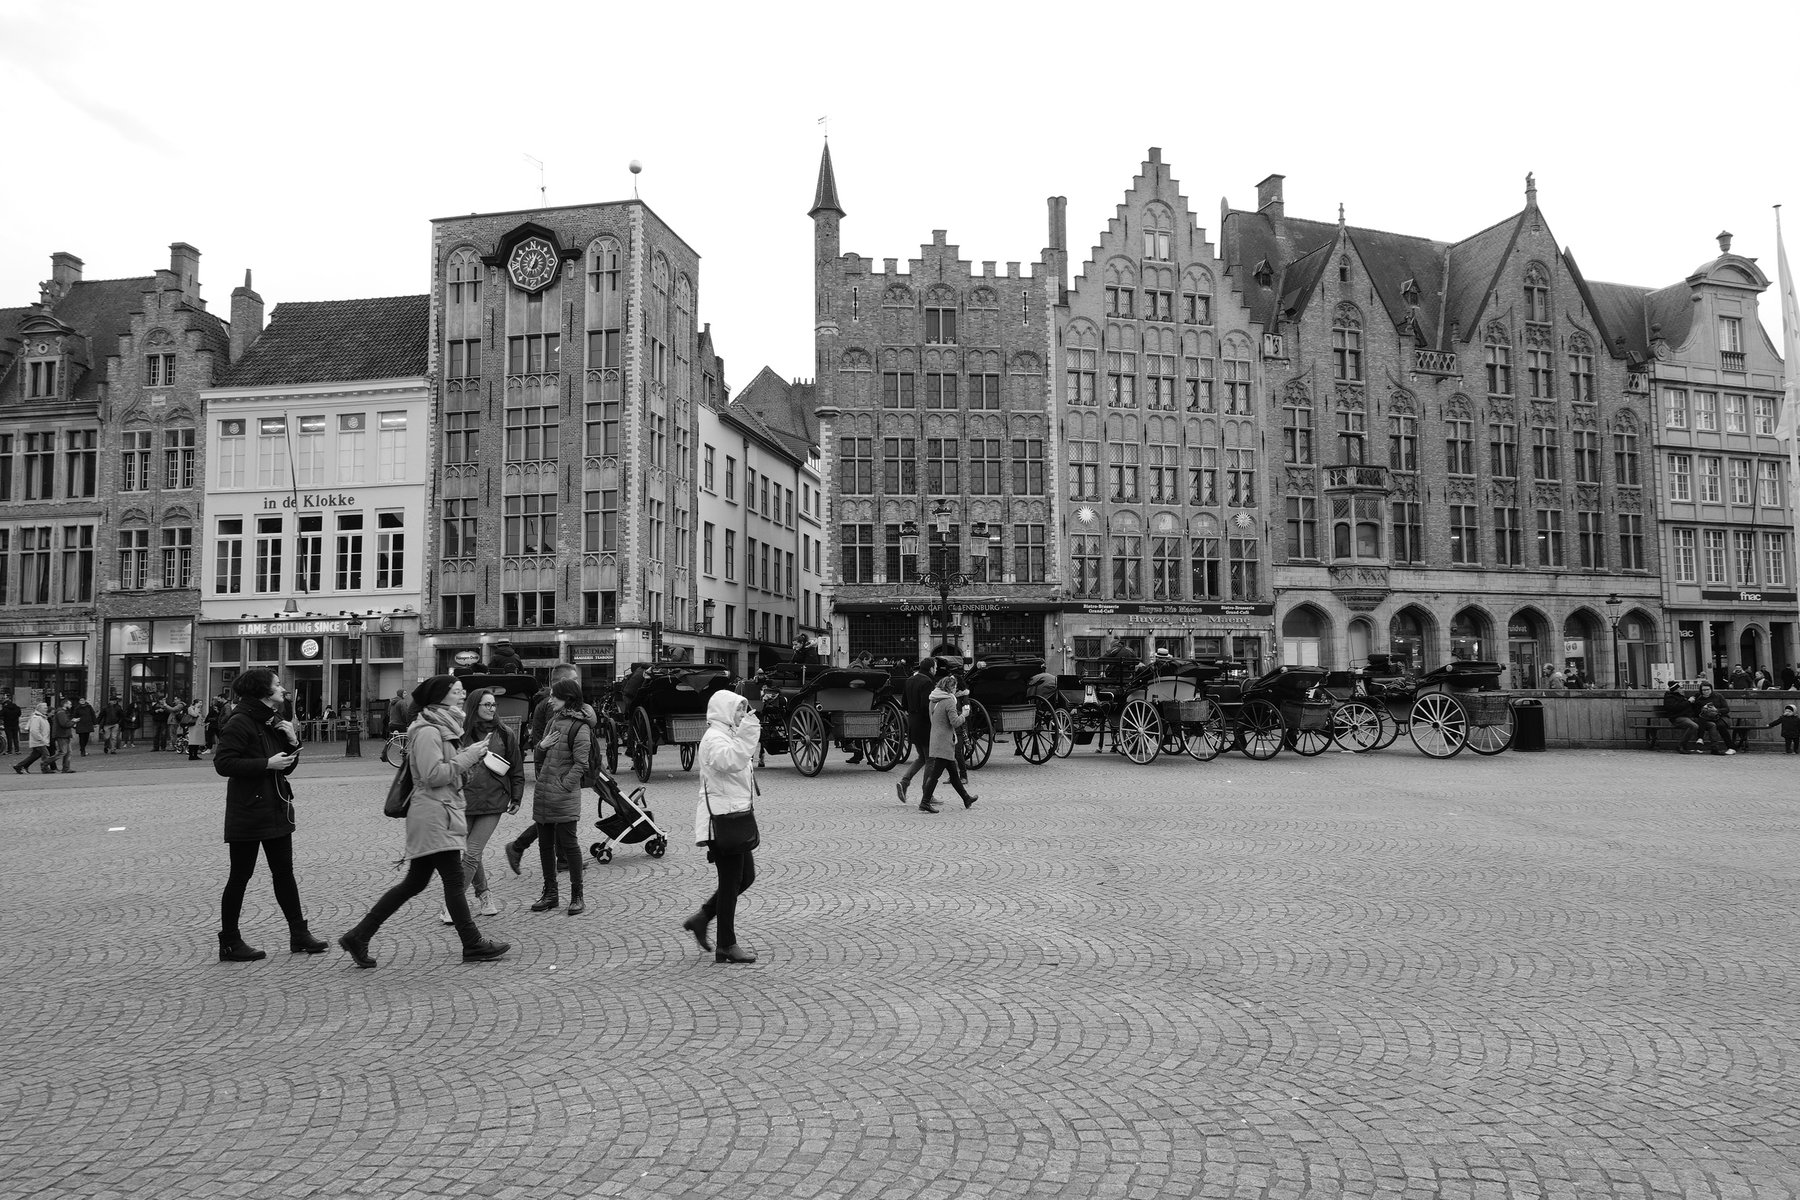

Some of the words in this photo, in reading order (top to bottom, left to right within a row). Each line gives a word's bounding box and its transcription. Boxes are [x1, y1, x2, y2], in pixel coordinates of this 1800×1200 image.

[263, 497, 277, 509] in
[282, 496, 297, 508] de
[303, 493, 355, 508] Klokke
[1740, 591, 1762, 601] fnac
[900, 604, 925, 612] GRAND
[928, 604, 943, 612] CAF
[1129, 615, 1170, 624] Huyze
[1179, 615, 1198, 623] die
[1208, 615, 1251, 624] Maene
[238, 623, 267, 635] FLAME
[269, 622, 311, 634] GRILLING
[314, 621, 340, 633] SINCE
[343, 620, 368, 632] 14
[1508, 624, 1527, 632] ruidvat
